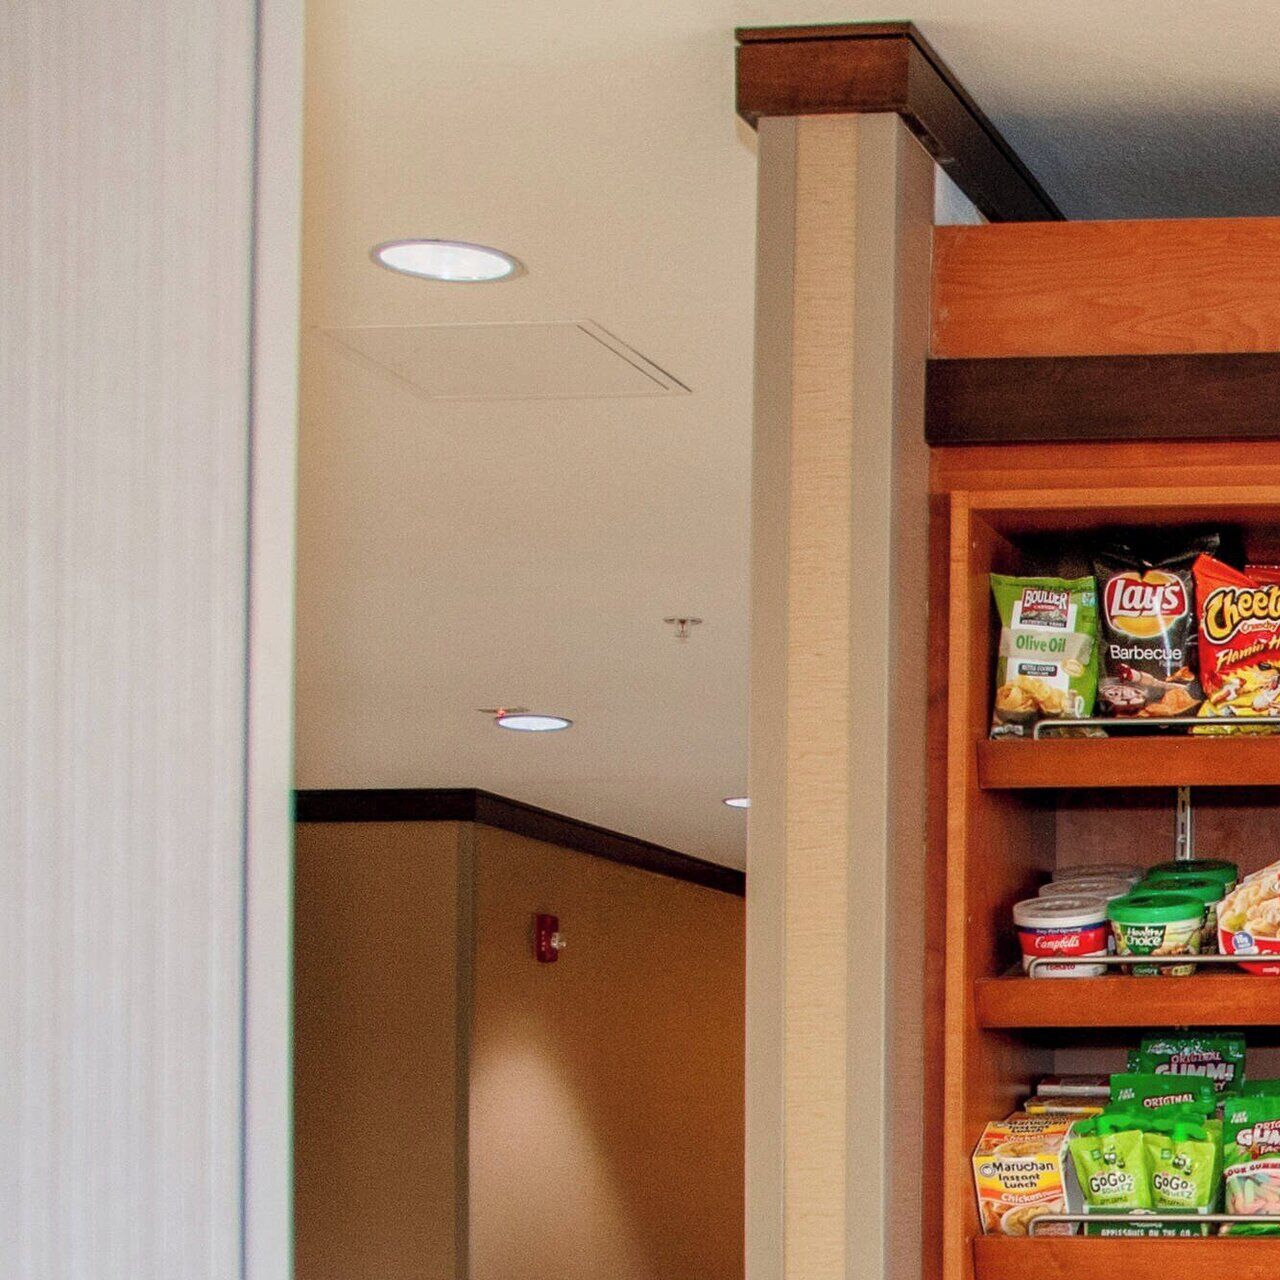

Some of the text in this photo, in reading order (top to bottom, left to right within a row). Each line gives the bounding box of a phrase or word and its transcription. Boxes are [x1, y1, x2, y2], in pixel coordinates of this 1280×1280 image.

[1024, 590, 1068, 609] BOULDER
[1112, 580, 1180, 616] Lay's
[1016, 635, 1066, 652] Olive Oil
[1110, 645, 1182, 661] Barbecue
[1127, 926, 1163, 937] Healthy
[1125, 935, 1161, 946] Choice
[1143, 1094, 1195, 1108] ORIGINAL
[993, 1160, 1054, 1173] Maruchan
[998, 1173, 1041, 1182] Instant
[1004, 1181, 1037, 1189] Lunch
[1090, 1173, 1127, 1193] GoGo
[1153, 1174, 1189, 1190] GoGo
